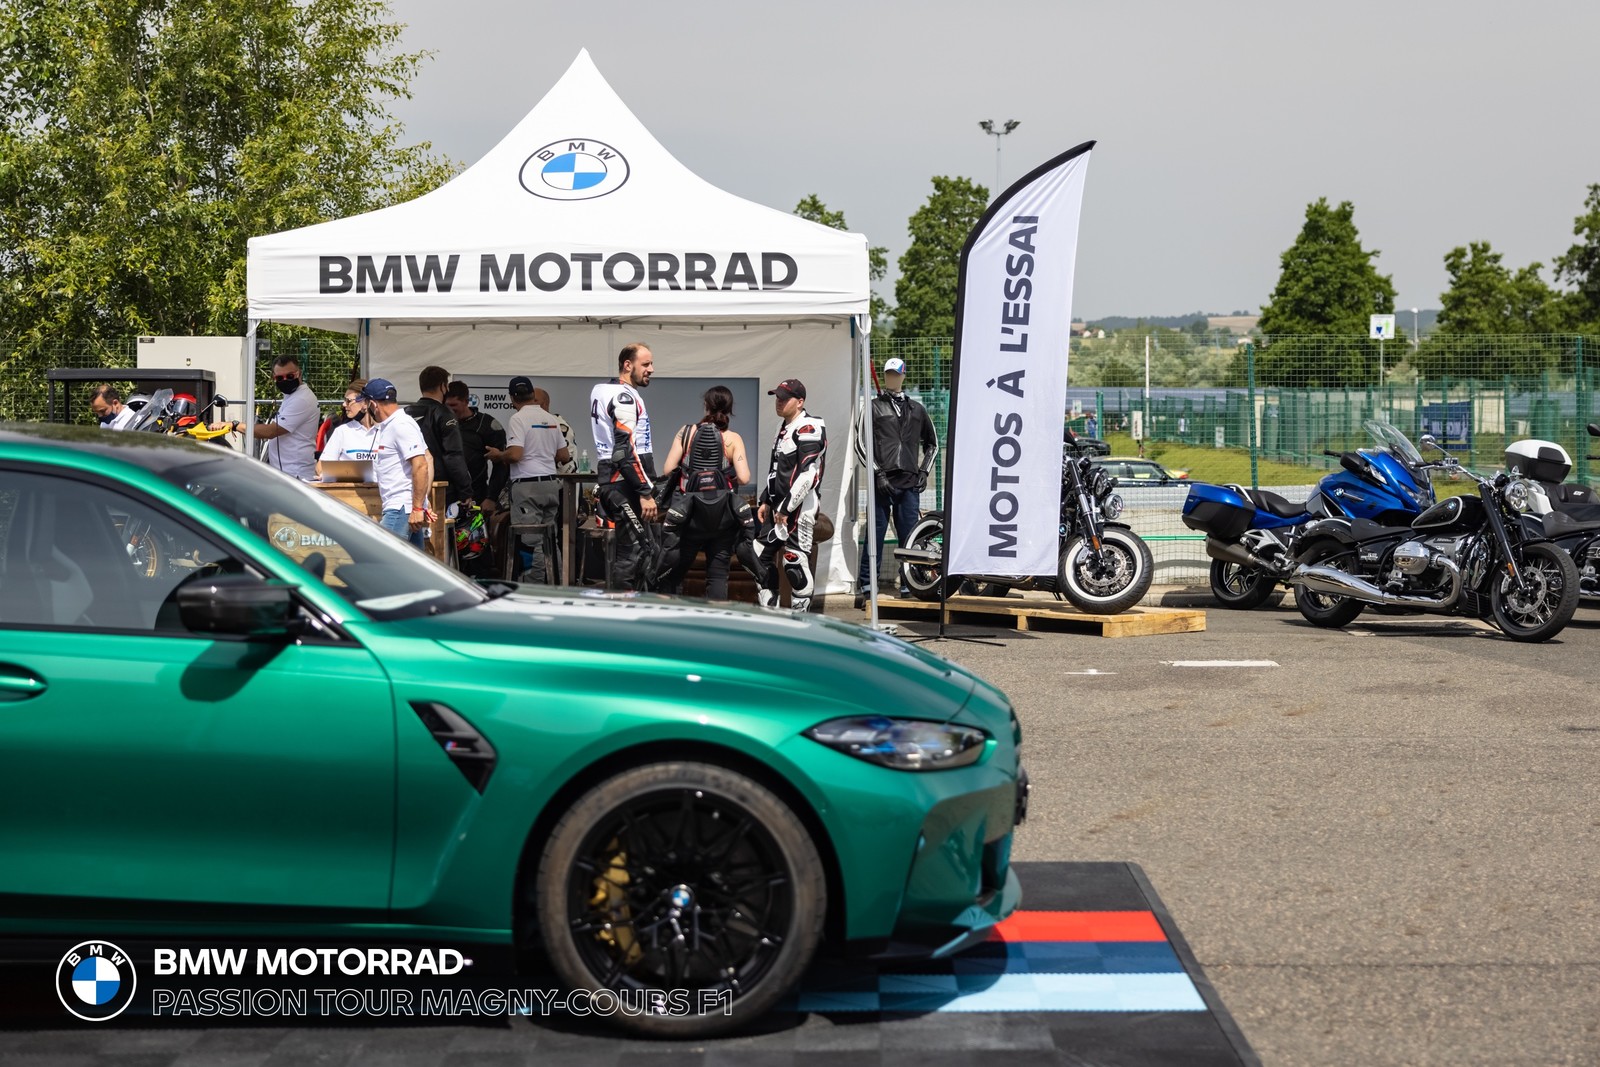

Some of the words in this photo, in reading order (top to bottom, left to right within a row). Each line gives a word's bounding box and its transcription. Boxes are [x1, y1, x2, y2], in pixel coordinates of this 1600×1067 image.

[537, 142, 616, 162] BMW
[319, 255, 461, 294] BMW
[480, 252, 799, 292] MOTORRAD
[1000, 215, 1039, 353] L'ESSAI
[986, 369, 1026, 398] À
[484, 402, 515, 410] MOTOR
[356, 452, 377, 460] BMW
[988, 412, 1023, 558] MOTOS
